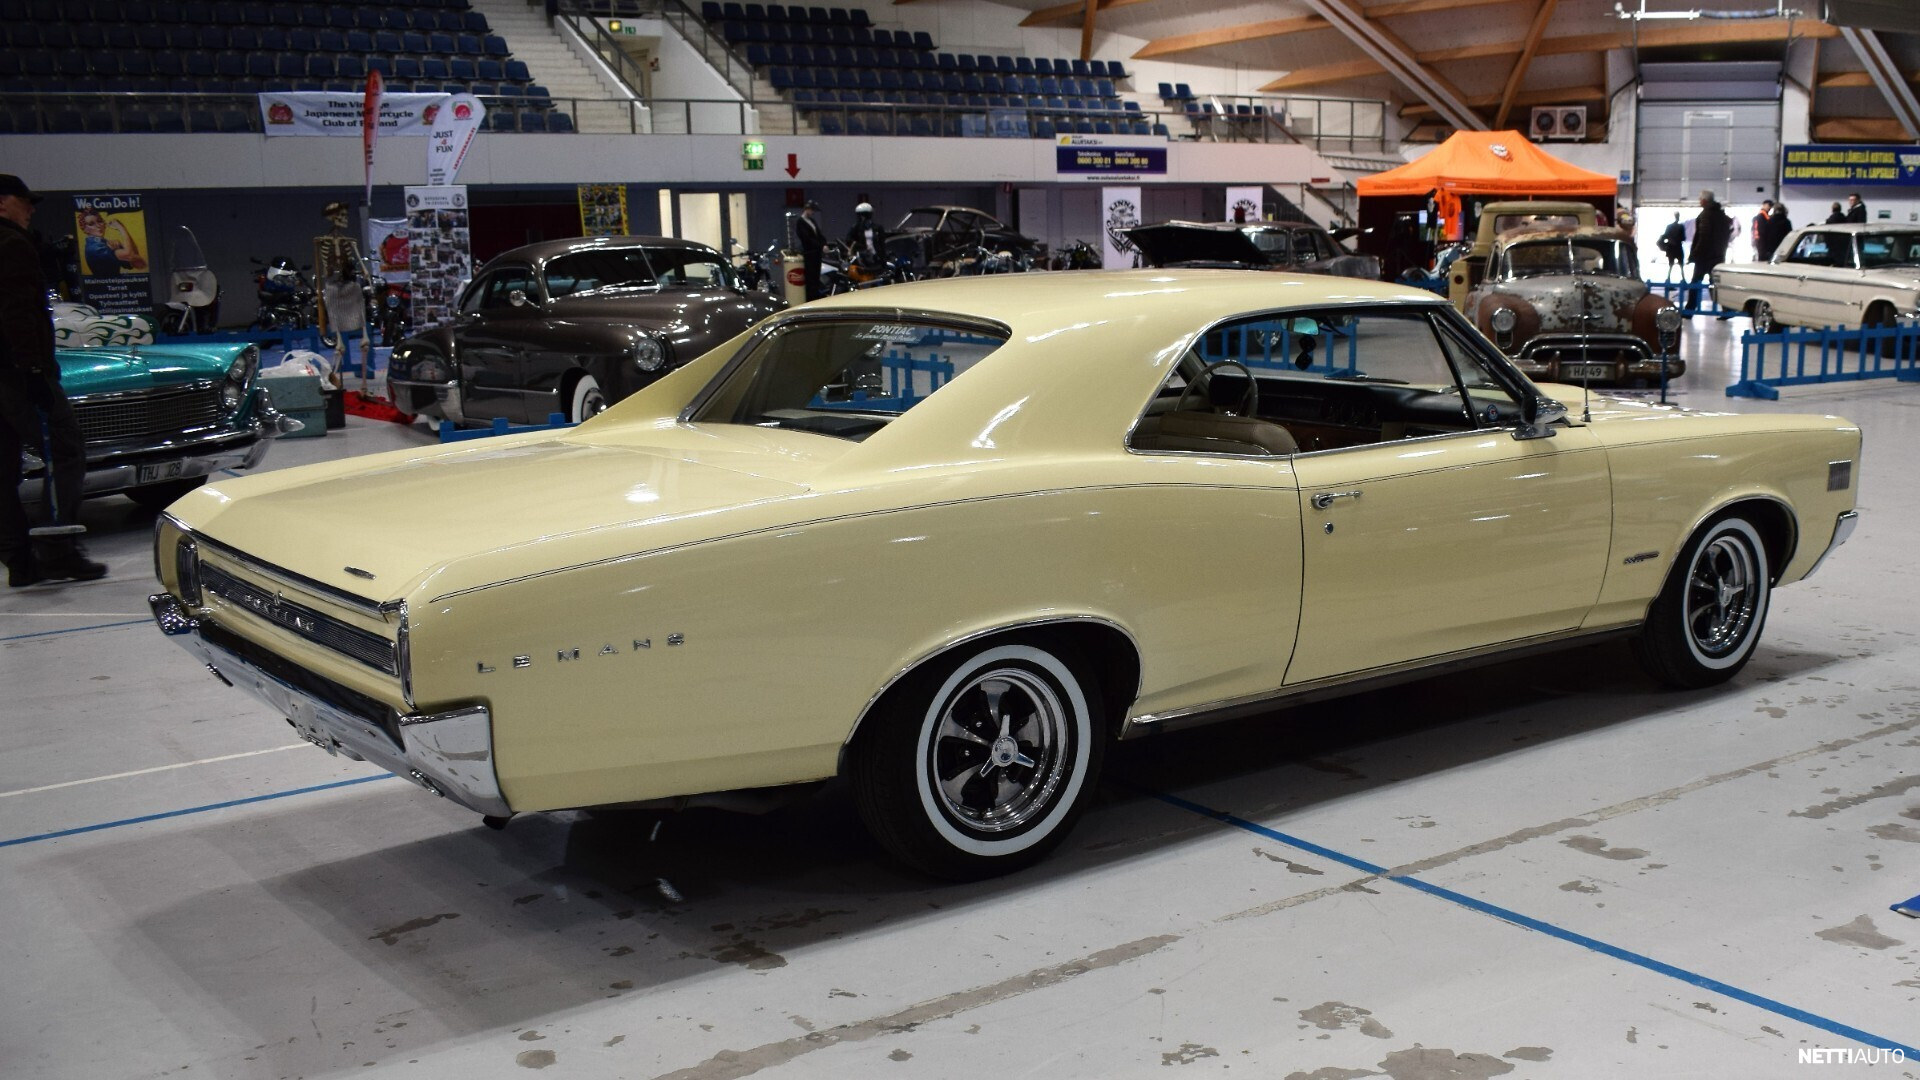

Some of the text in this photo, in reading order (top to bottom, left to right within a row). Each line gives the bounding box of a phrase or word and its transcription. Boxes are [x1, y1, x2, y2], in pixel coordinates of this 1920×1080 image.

[304, 110, 354, 119] Japanese
[322, 119, 345, 127] Club
[347, 119, 357, 127] of
[433, 130, 453, 139] JUST
[436, 145, 453, 153] FUN
[76, 197, 140, 209] We Can Do It!
[1109, 200, 1135, 212] LINNA
[1232, 199, 1257, 211] LINNA
[129, 291, 147, 299] kyltit
[869, 325, 915, 335] PONTIAC
[143, 464, 160, 483] THJ
[243, 594, 315, 633] PONTIAC
[477, 632, 685, 674] LE MANS
